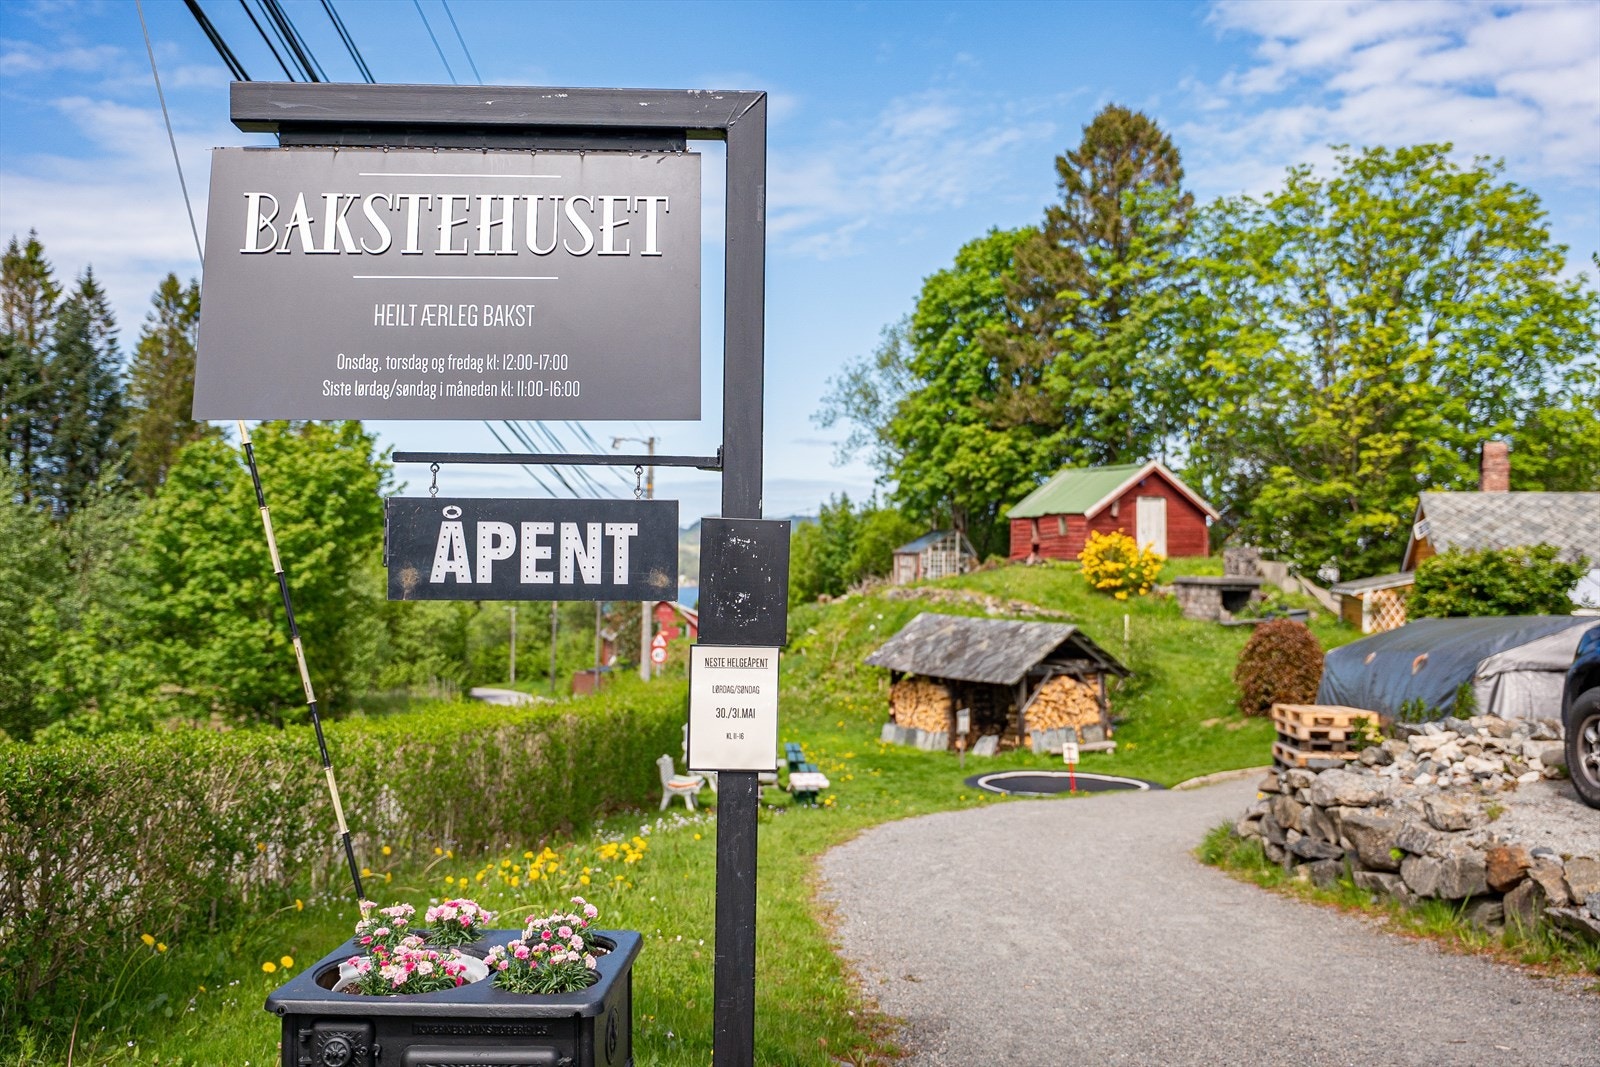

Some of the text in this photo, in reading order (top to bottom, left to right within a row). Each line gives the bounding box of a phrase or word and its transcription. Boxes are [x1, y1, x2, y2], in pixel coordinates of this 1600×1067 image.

[239, 191, 670, 256] BAKSTEHUSET
[373, 303, 536, 327] HEILT ÆRLEG BAKST
[336, 353, 569, 374] Onsdag, torsdag og fredag kl: 12:00-17:00
[322, 379, 581, 400] Siste lørdag/søndag i måneden kl: 11:00-16:00
[429, 505, 639, 585] ÅPENT
[705, 656, 768, 668] NESTE HELGEÅPENT
[712, 685, 760, 695] LØRDAG/SØNDAG
[716, 707, 756, 719] 30./31.MAI
[733, 732, 744, 740] 11-16
